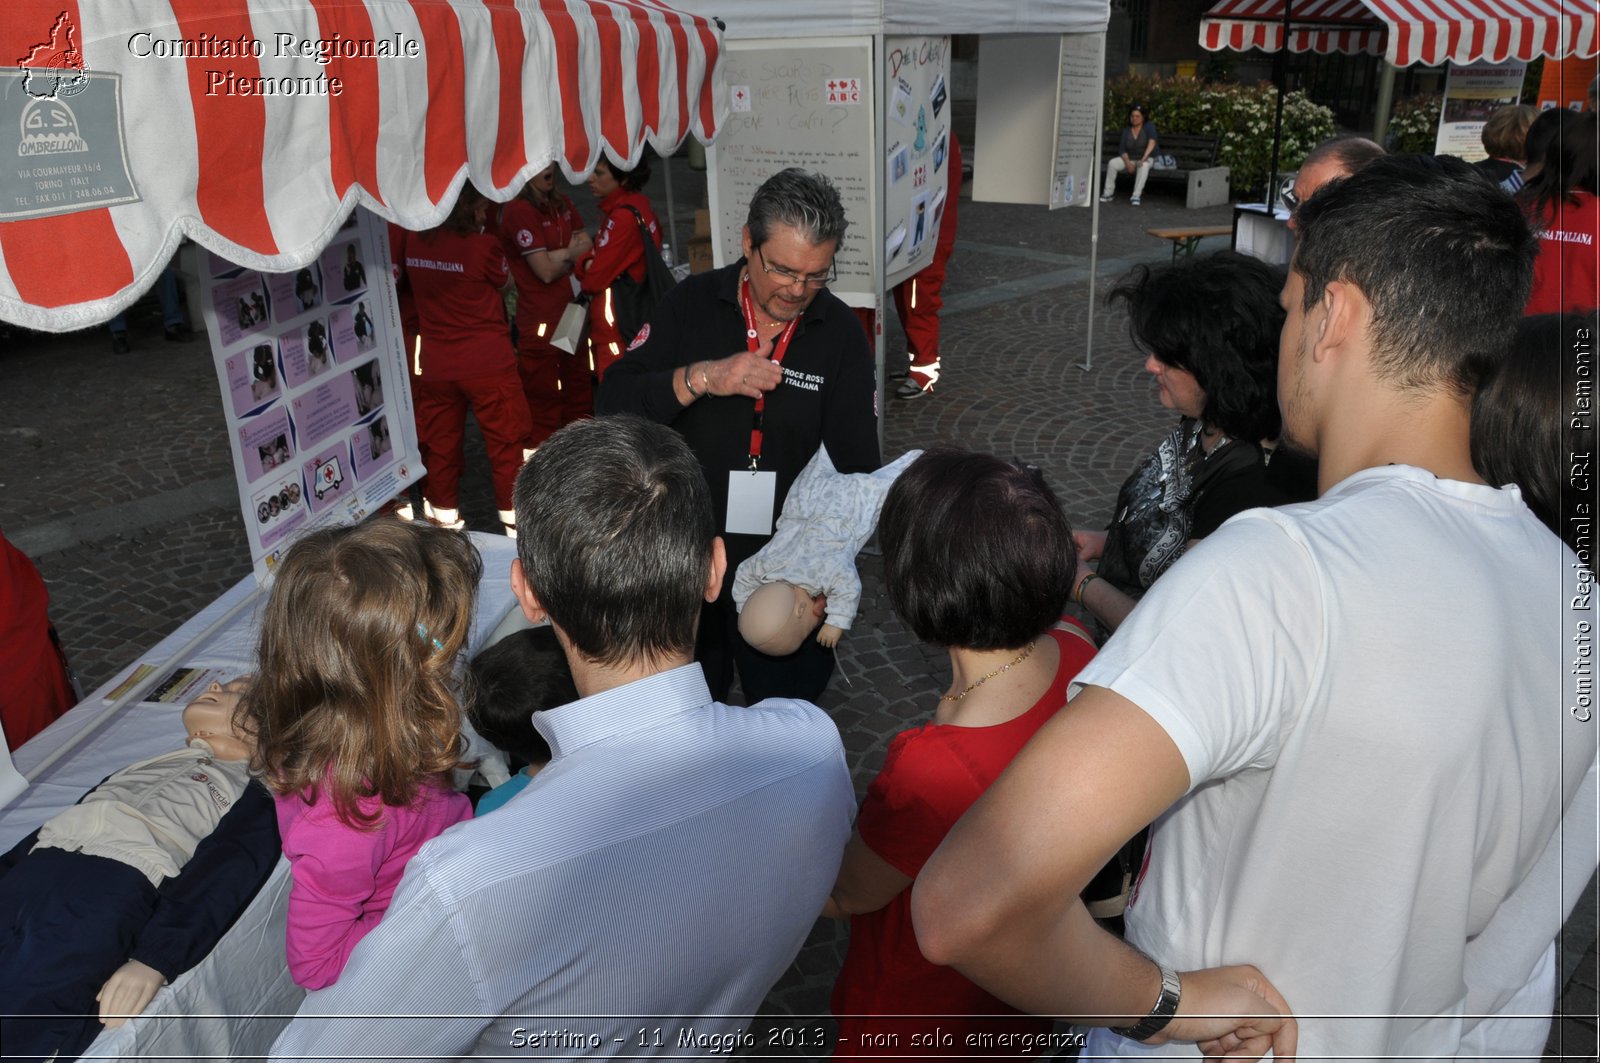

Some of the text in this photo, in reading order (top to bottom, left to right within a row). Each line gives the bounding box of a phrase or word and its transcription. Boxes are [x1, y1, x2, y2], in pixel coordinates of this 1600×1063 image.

[20, 138, 84, 155] OMBRELLONI
[18, 169, 31, 179] VIA
[33, 164, 82, 178] COURMAYEUR
[35, 176, 90, 190] TORINO ITALY
[35, 194, 50, 203] FAX
[52, 192, 66, 202] 011
[76, 185, 115, 199] 248.06.04
[1554, 230, 1592, 245] ITALIANA
[437, 260, 464, 273] ITALIANA
[785, 377, 819, 392] ITALIANA
[207, 781, 231, 808] Laerdal
